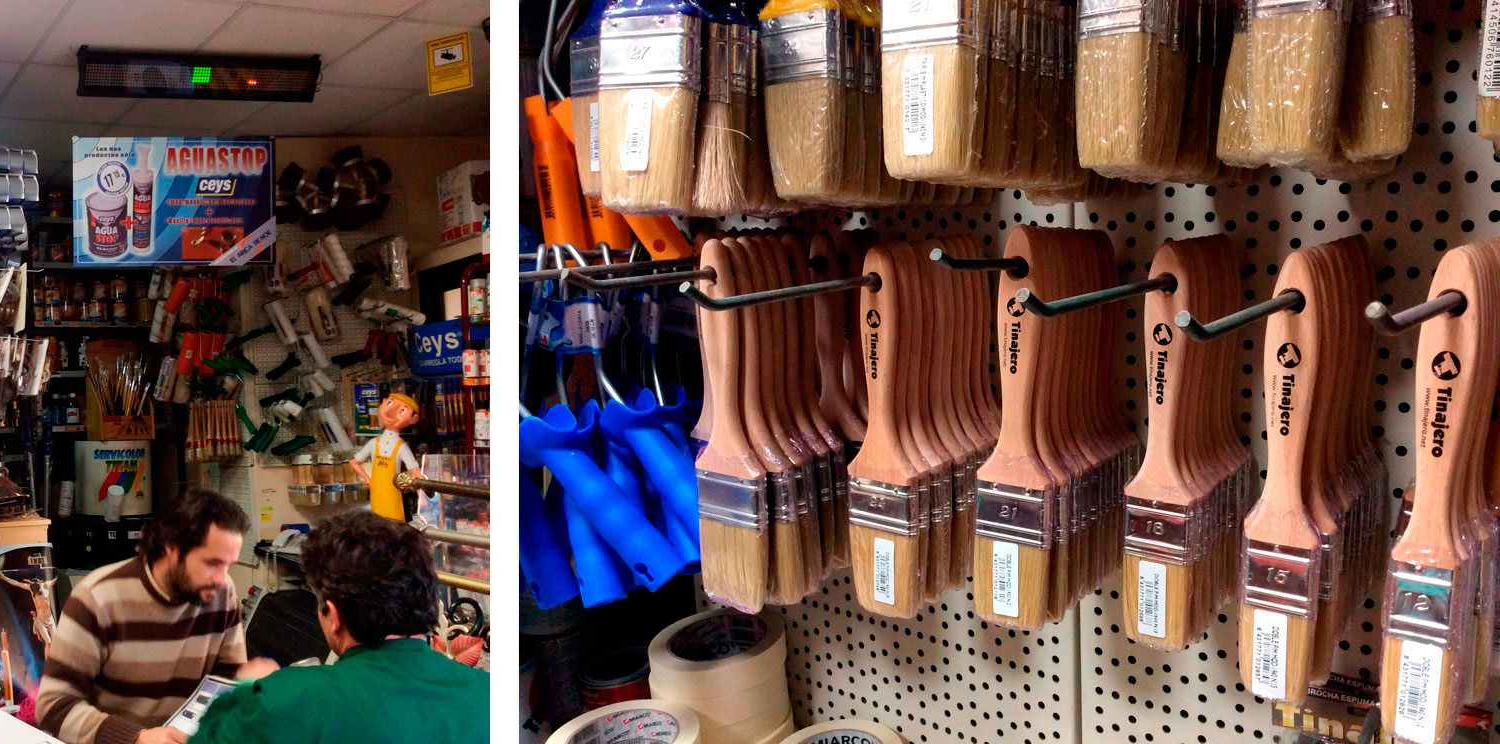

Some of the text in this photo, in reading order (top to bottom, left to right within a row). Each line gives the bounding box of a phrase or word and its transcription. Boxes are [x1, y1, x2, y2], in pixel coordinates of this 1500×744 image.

[1484, 0, 1499, 87] 414506 760122
[630, 46, 651, 59] 27
[166, 147, 266, 174] AGUASTOP
[103, 173, 114, 187] 17
[199, 179, 231, 193] ceys
[95, 226, 118, 235] AGUA
[96, 234, 118, 243] STOP
[415, 331, 459, 357] Ceys
[1009, 322, 1022, 374] Tinajero
[870, 333, 879, 379] Tinajero
[1155, 351, 1167, 405] Tinajero
[1278, 373, 1295, 437] Tinajero
[1420, 388, 1430, 448] www.tinajero.net
[1431, 386, 1453, 458] Tinajero
[94, 448, 145, 460] SERVICOLOR
[105, 460, 138, 472] TITAN
[999, 505, 1017, 520] 21
[1146, 520, 1164, 536] 18
[1267, 567, 1290, 584] 15
[1403, 592, 1429, 610] 12
[1271, 626, 1279, 644] DOBLE
[1421, 658, 1430, 677] DOBLE
[1347, 679, 1374, 689] ESPUM
[1341, 696, 1375, 705] ESPUMA
[629, 712, 650, 722] MIARCO
